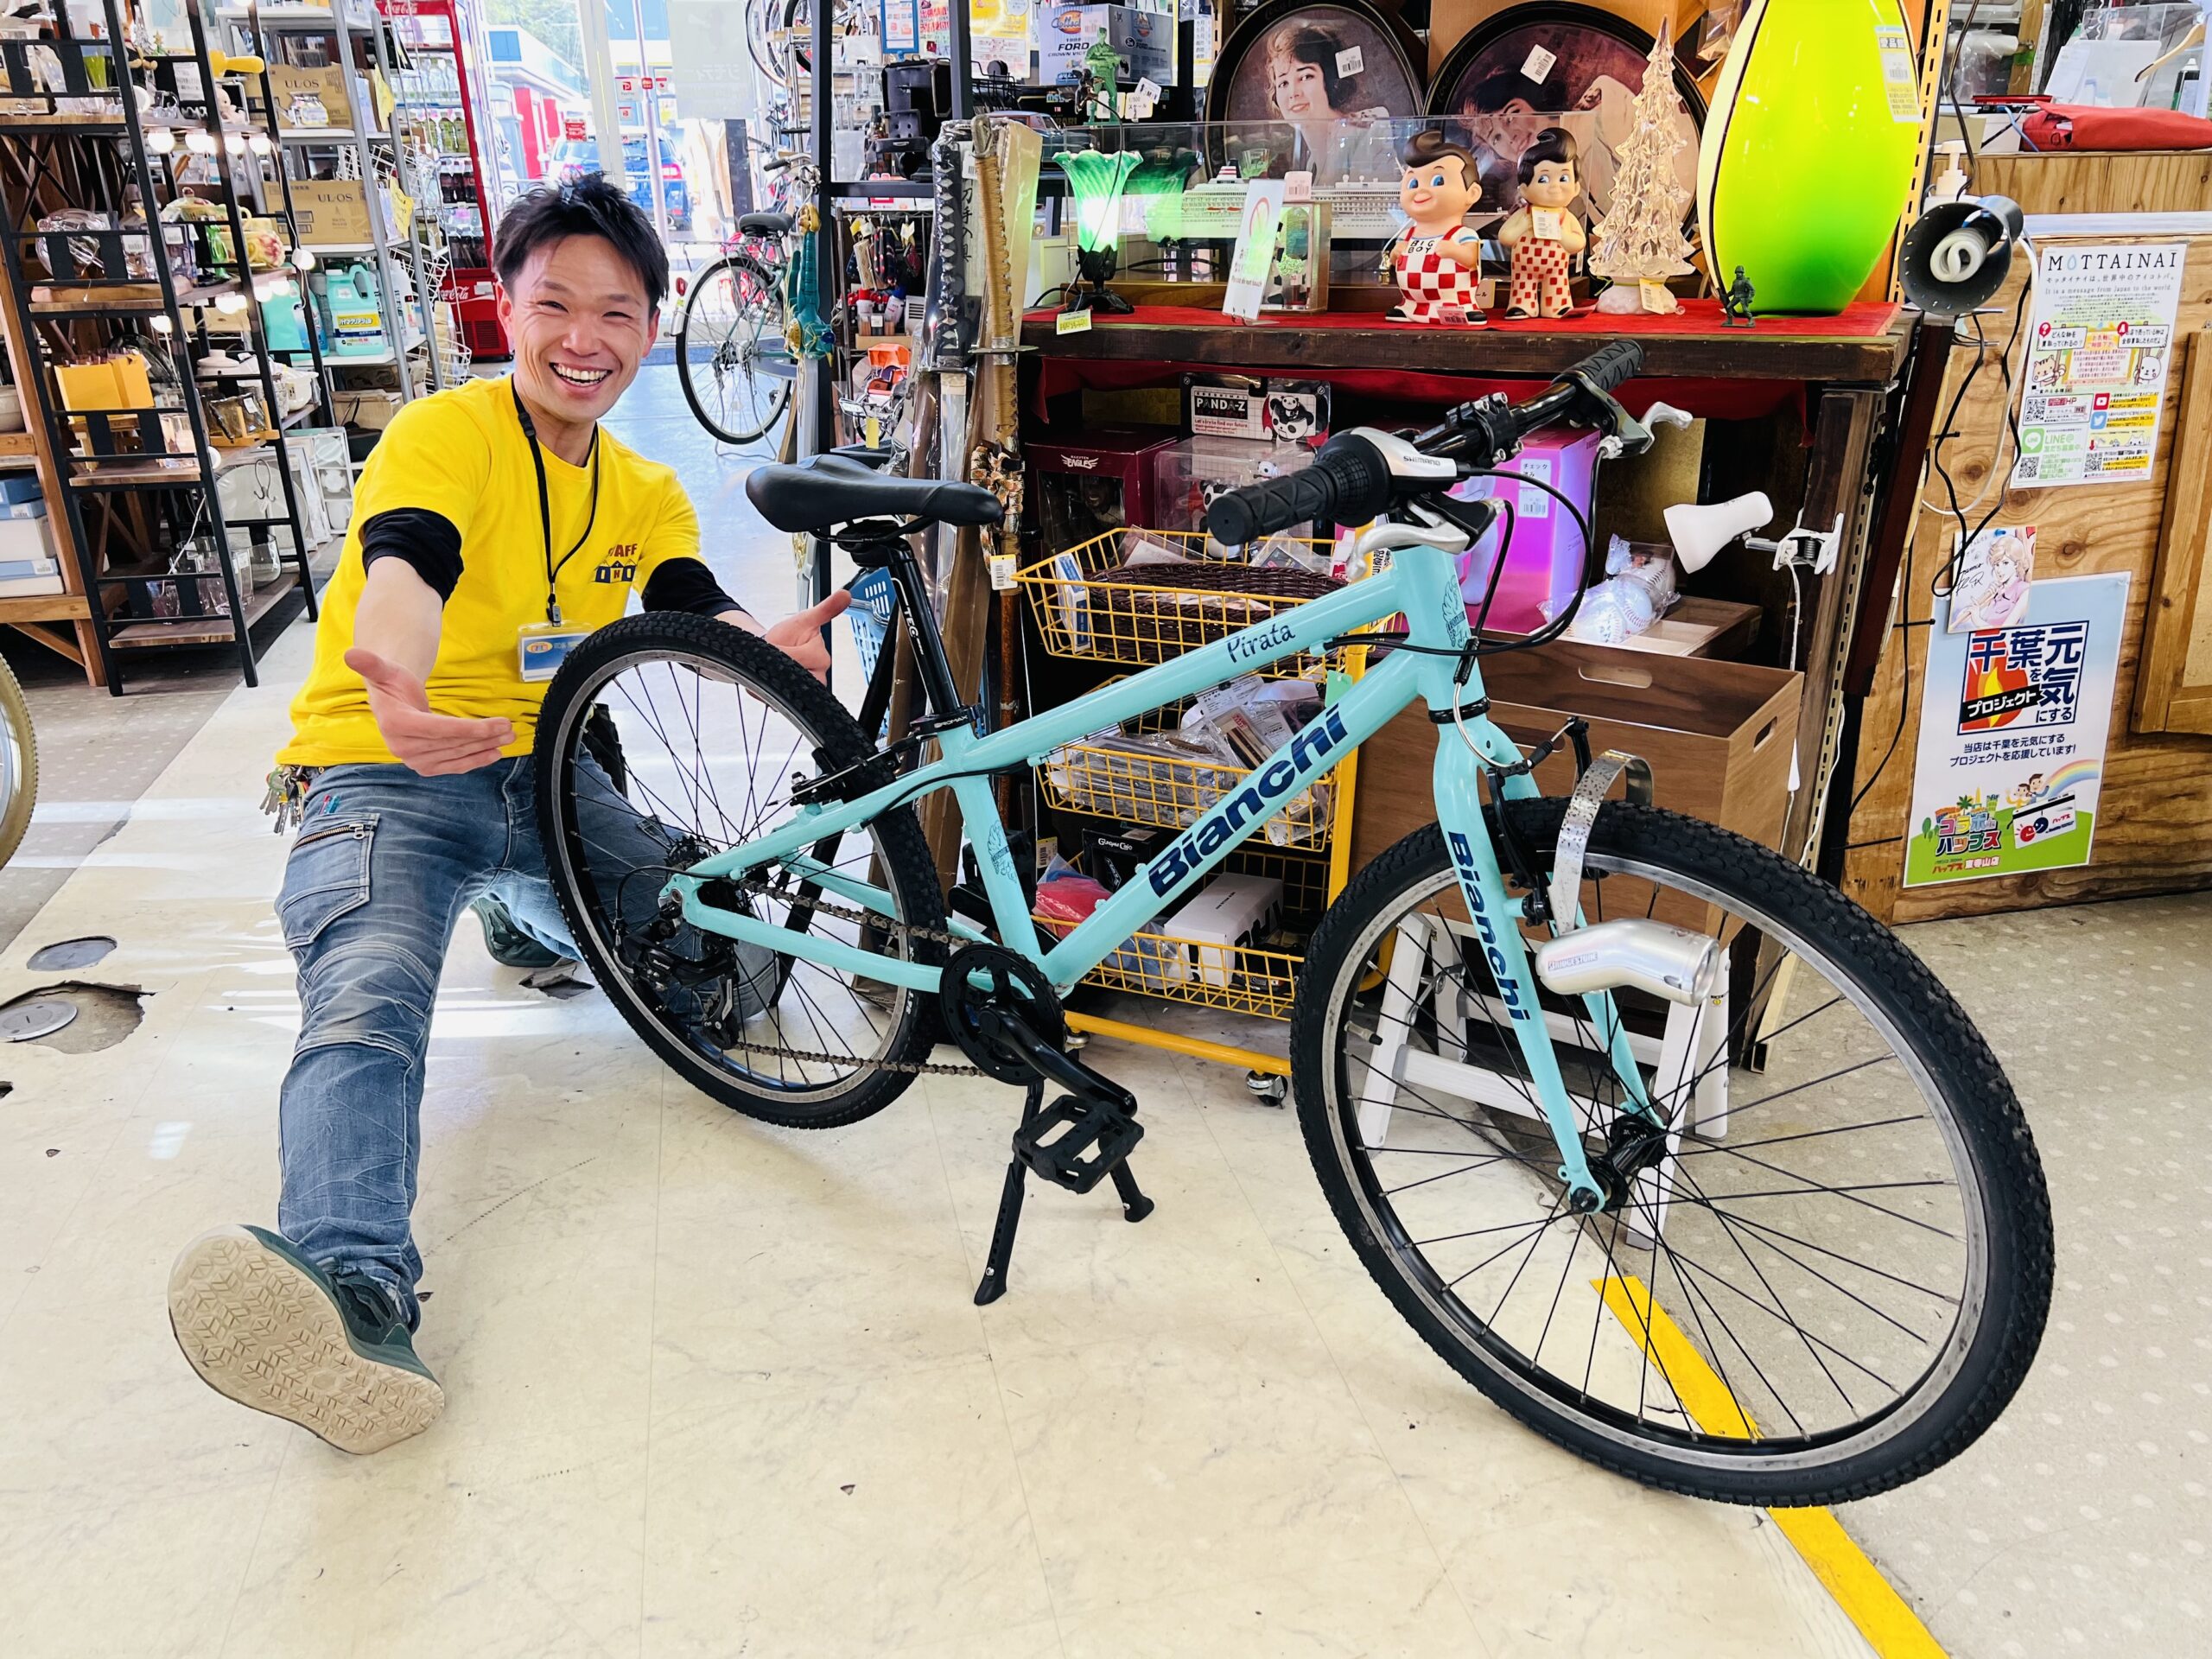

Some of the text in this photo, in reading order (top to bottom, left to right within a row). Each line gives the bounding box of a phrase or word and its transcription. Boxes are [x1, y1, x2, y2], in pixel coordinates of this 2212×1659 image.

[1058, 42, 1090, 51] FORD
[1197, 397, 1246, 412] PANDA-Z
[1403, 455, 1440, 466] SHIMANO
[608, 543, 638, 557] AFF
[904, 605, 919, 639] TEC
[1227, 624, 1295, 663] Pirata
[1967, 690, 2037, 717] プロジェクト
[2036, 707, 2073, 723] にする
[1963, 734, 2065, 753] 当店は千葉を元気にする
[1148, 703, 1348, 898] Bianchi
[1936, 830, 2000, 855] ハップス
[1448, 831, 1530, 1020] Bianchi
[1548, 951, 1598, 971] BRIDGESTONE
